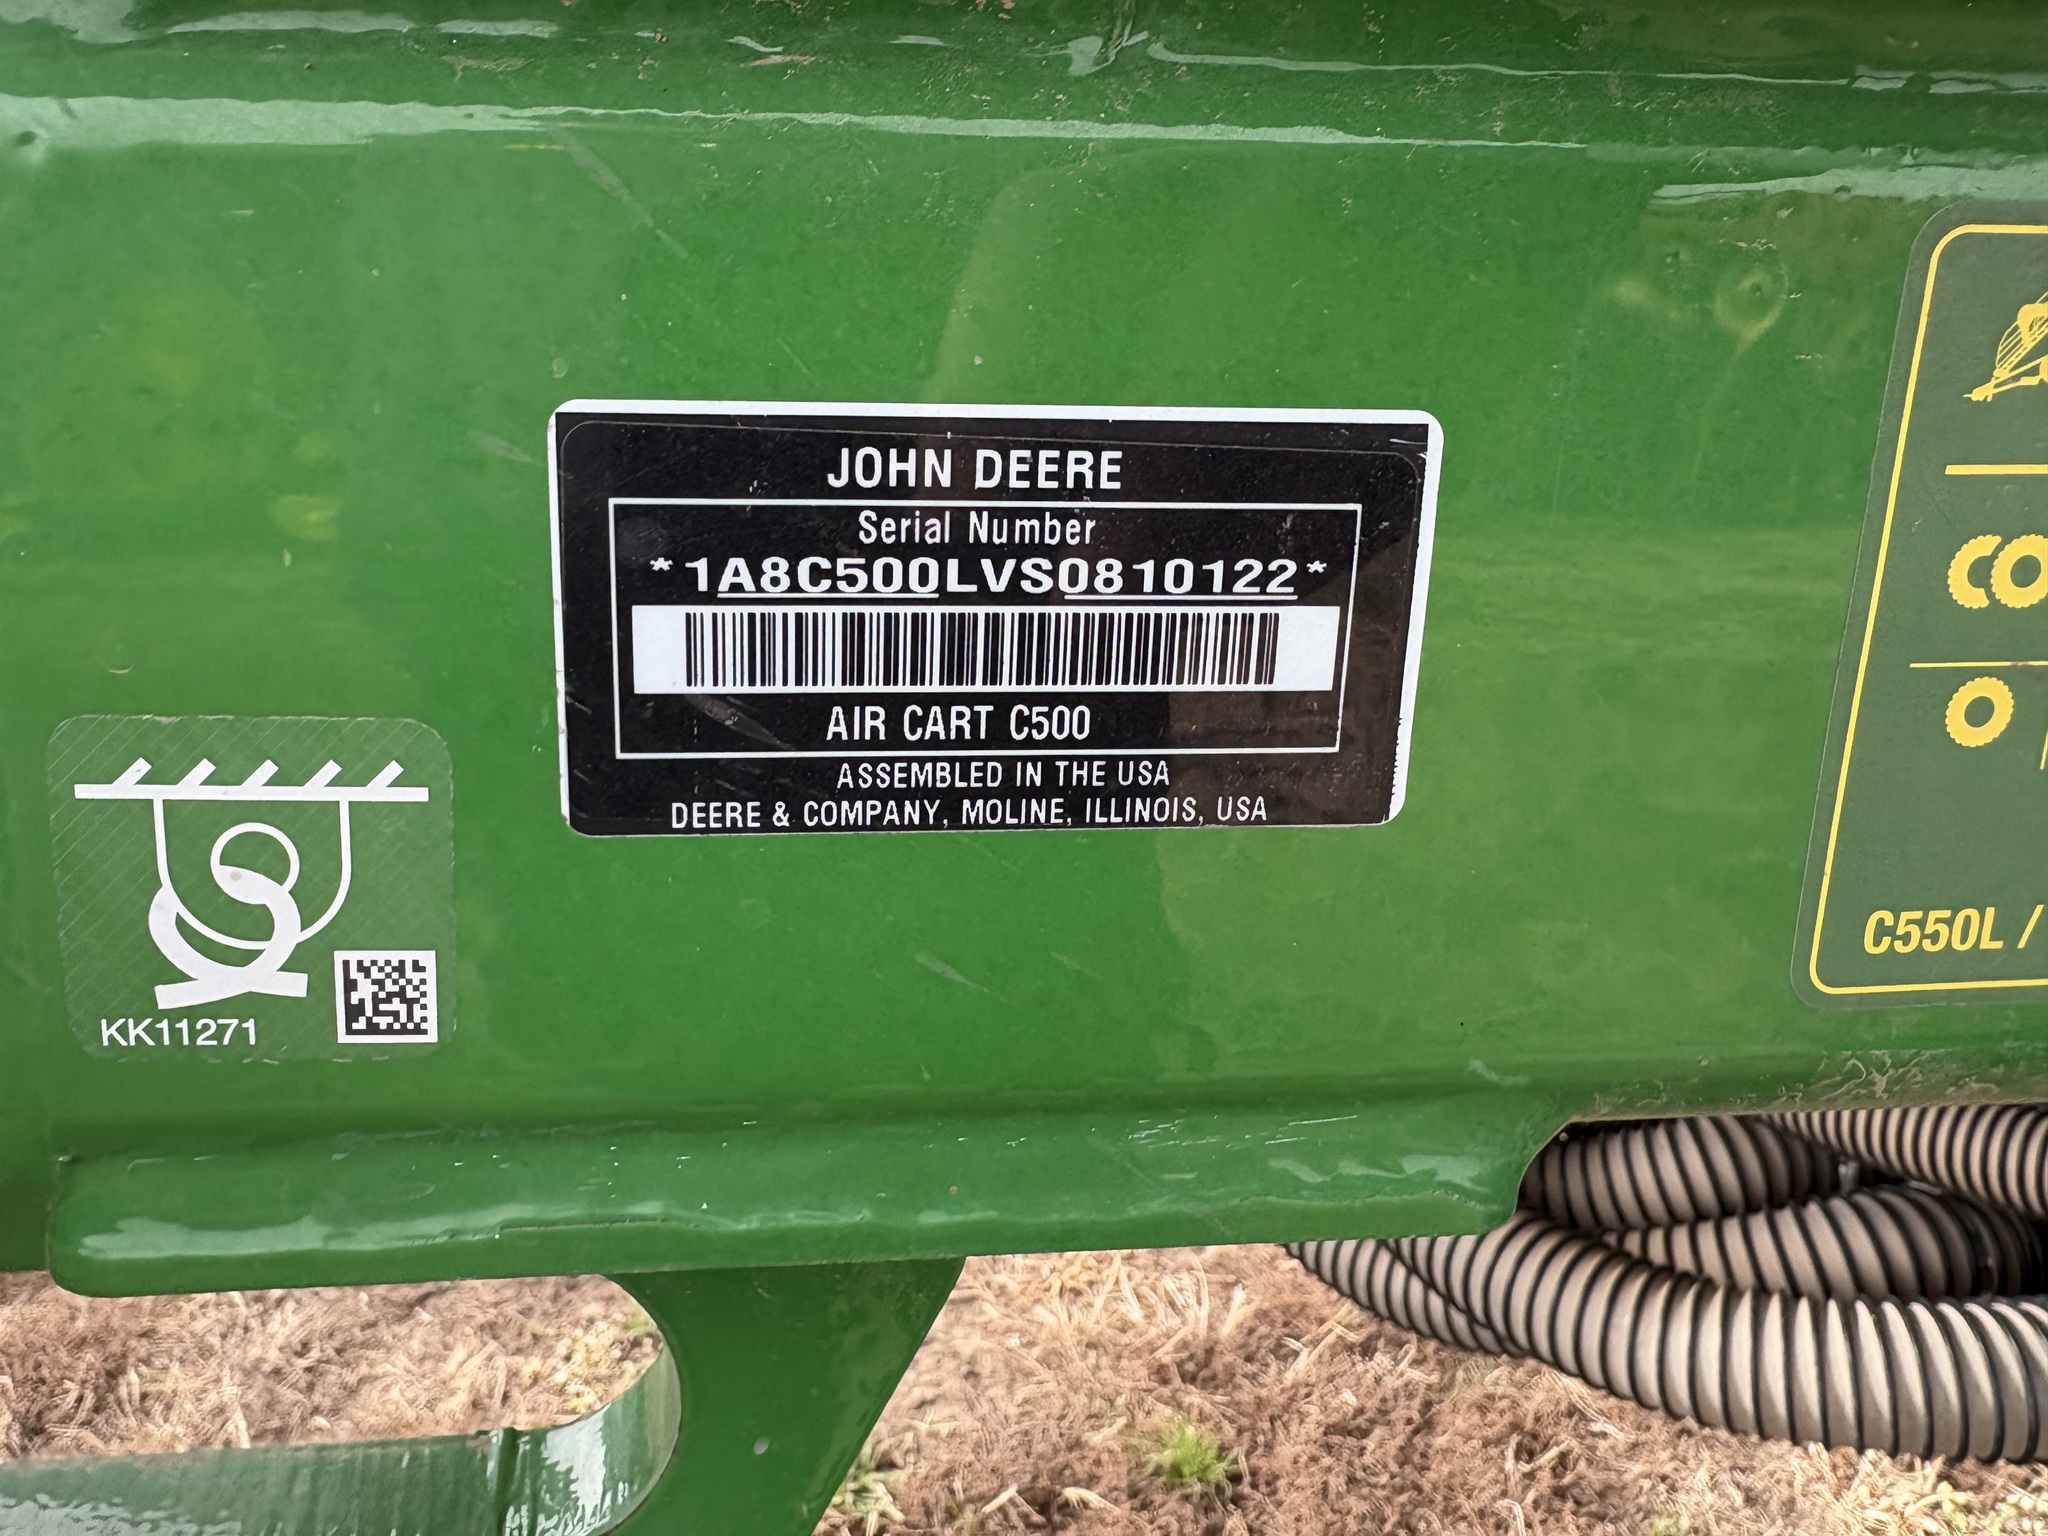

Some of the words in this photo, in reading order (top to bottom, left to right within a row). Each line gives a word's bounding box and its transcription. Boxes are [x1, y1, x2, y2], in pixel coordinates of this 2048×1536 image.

[827, 446, 953, 489] JOHN
[974, 449, 1124, 491] DEERE
[857, 509, 952, 545] Serial
[968, 510, 1096, 546] Number
[826, 705, 887, 741] AIR
[903, 704, 994, 742] CART
[1009, 704, 1091, 741] C500
[836, 761, 1003, 790] ASSEMBLED
[1016, 761, 1043, 788] IN
[1054, 760, 1107, 787] THE
[1118, 760, 1170, 787] USA
[671, 802, 761, 829] DEERE
[772, 801, 790, 828] &
[803, 799, 950, 829] COMPANY,
[961, 798, 1073, 827] MOLINE,
[1085, 796, 1205, 825] ILLINOIS,
[1216, 796, 1268, 823] USA
[1863, 907, 2004, 954] C550L
[101, 1018, 257, 1047] KK11271
